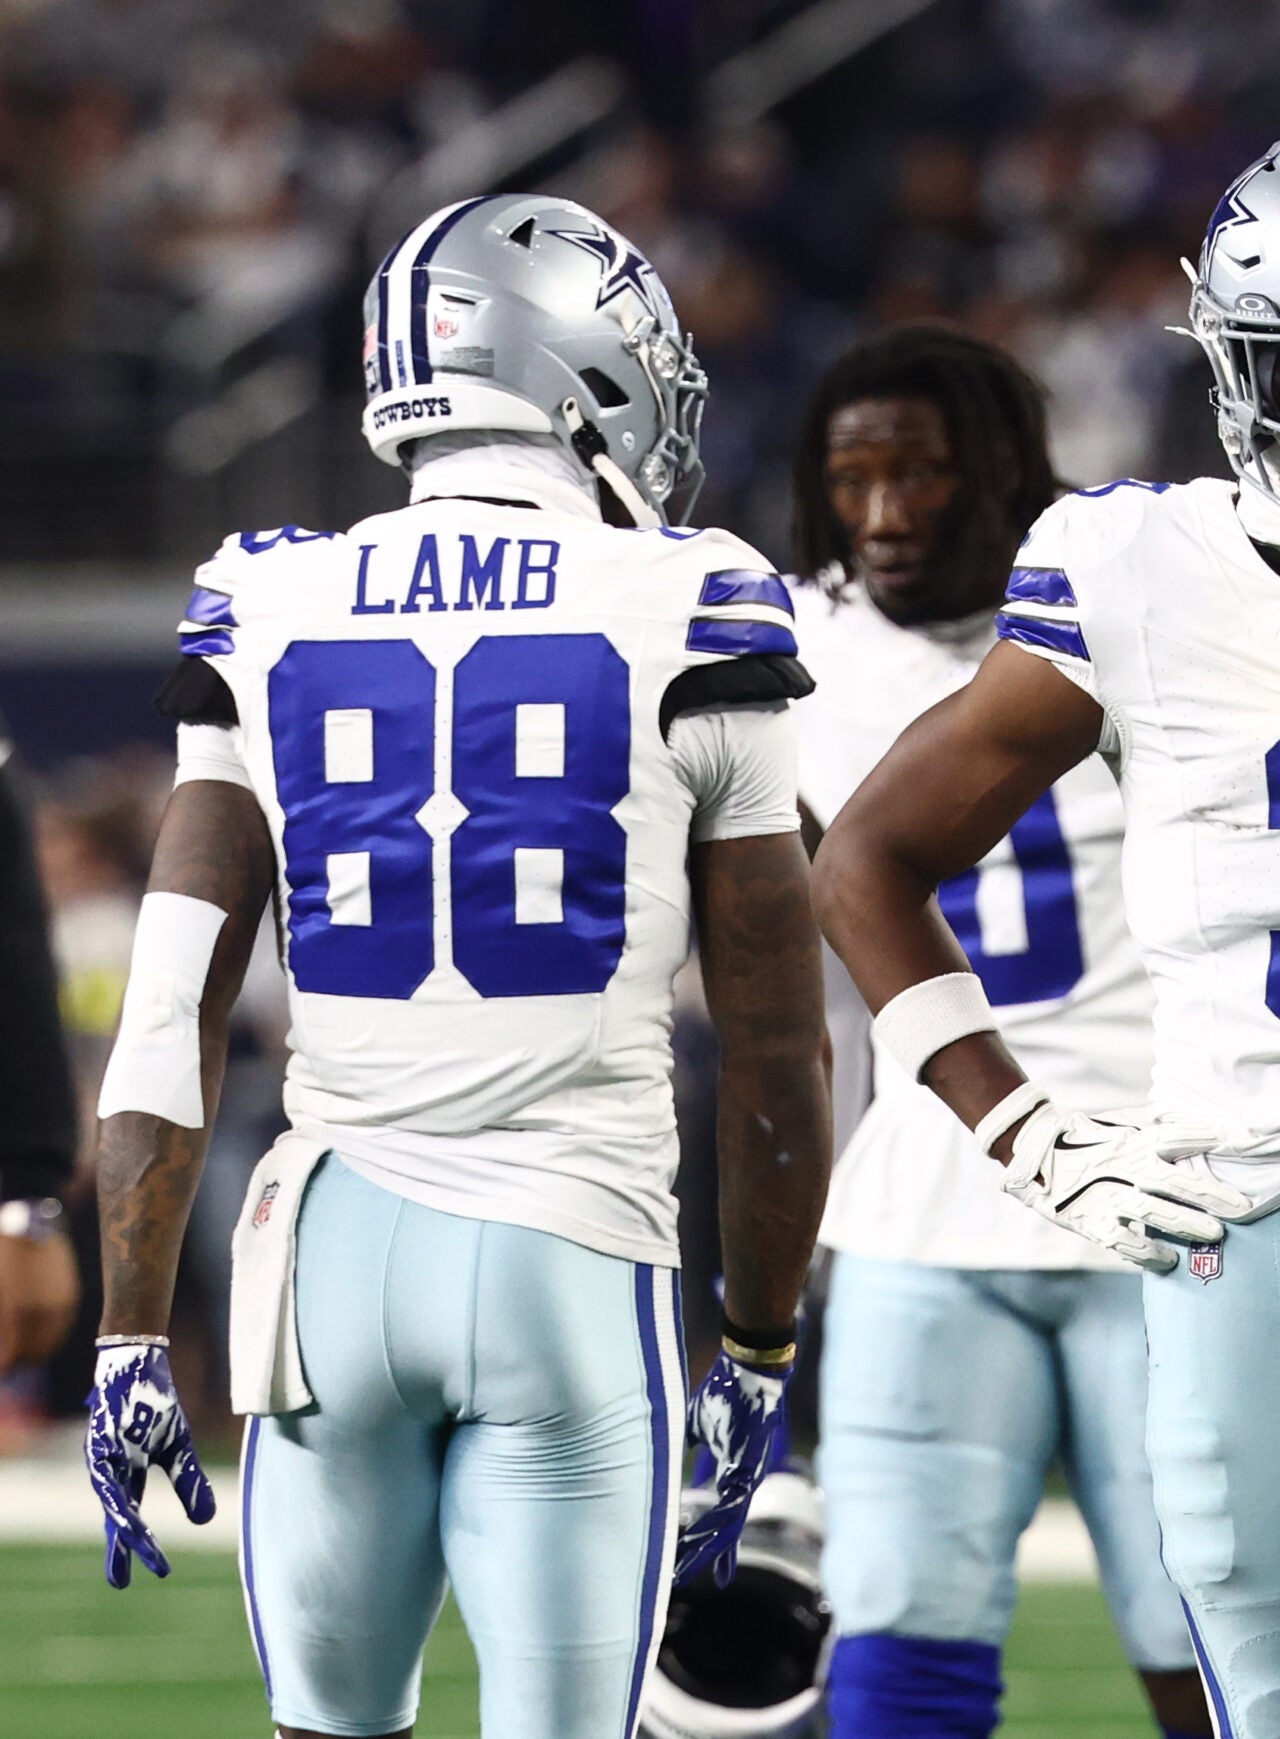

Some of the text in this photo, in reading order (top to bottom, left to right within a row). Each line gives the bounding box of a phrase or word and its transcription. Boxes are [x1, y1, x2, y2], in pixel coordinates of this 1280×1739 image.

[351, 533, 560, 615] LAMB
[268, 633, 632, 999] 88
[1193, 1255, 1217, 1275] NFL
